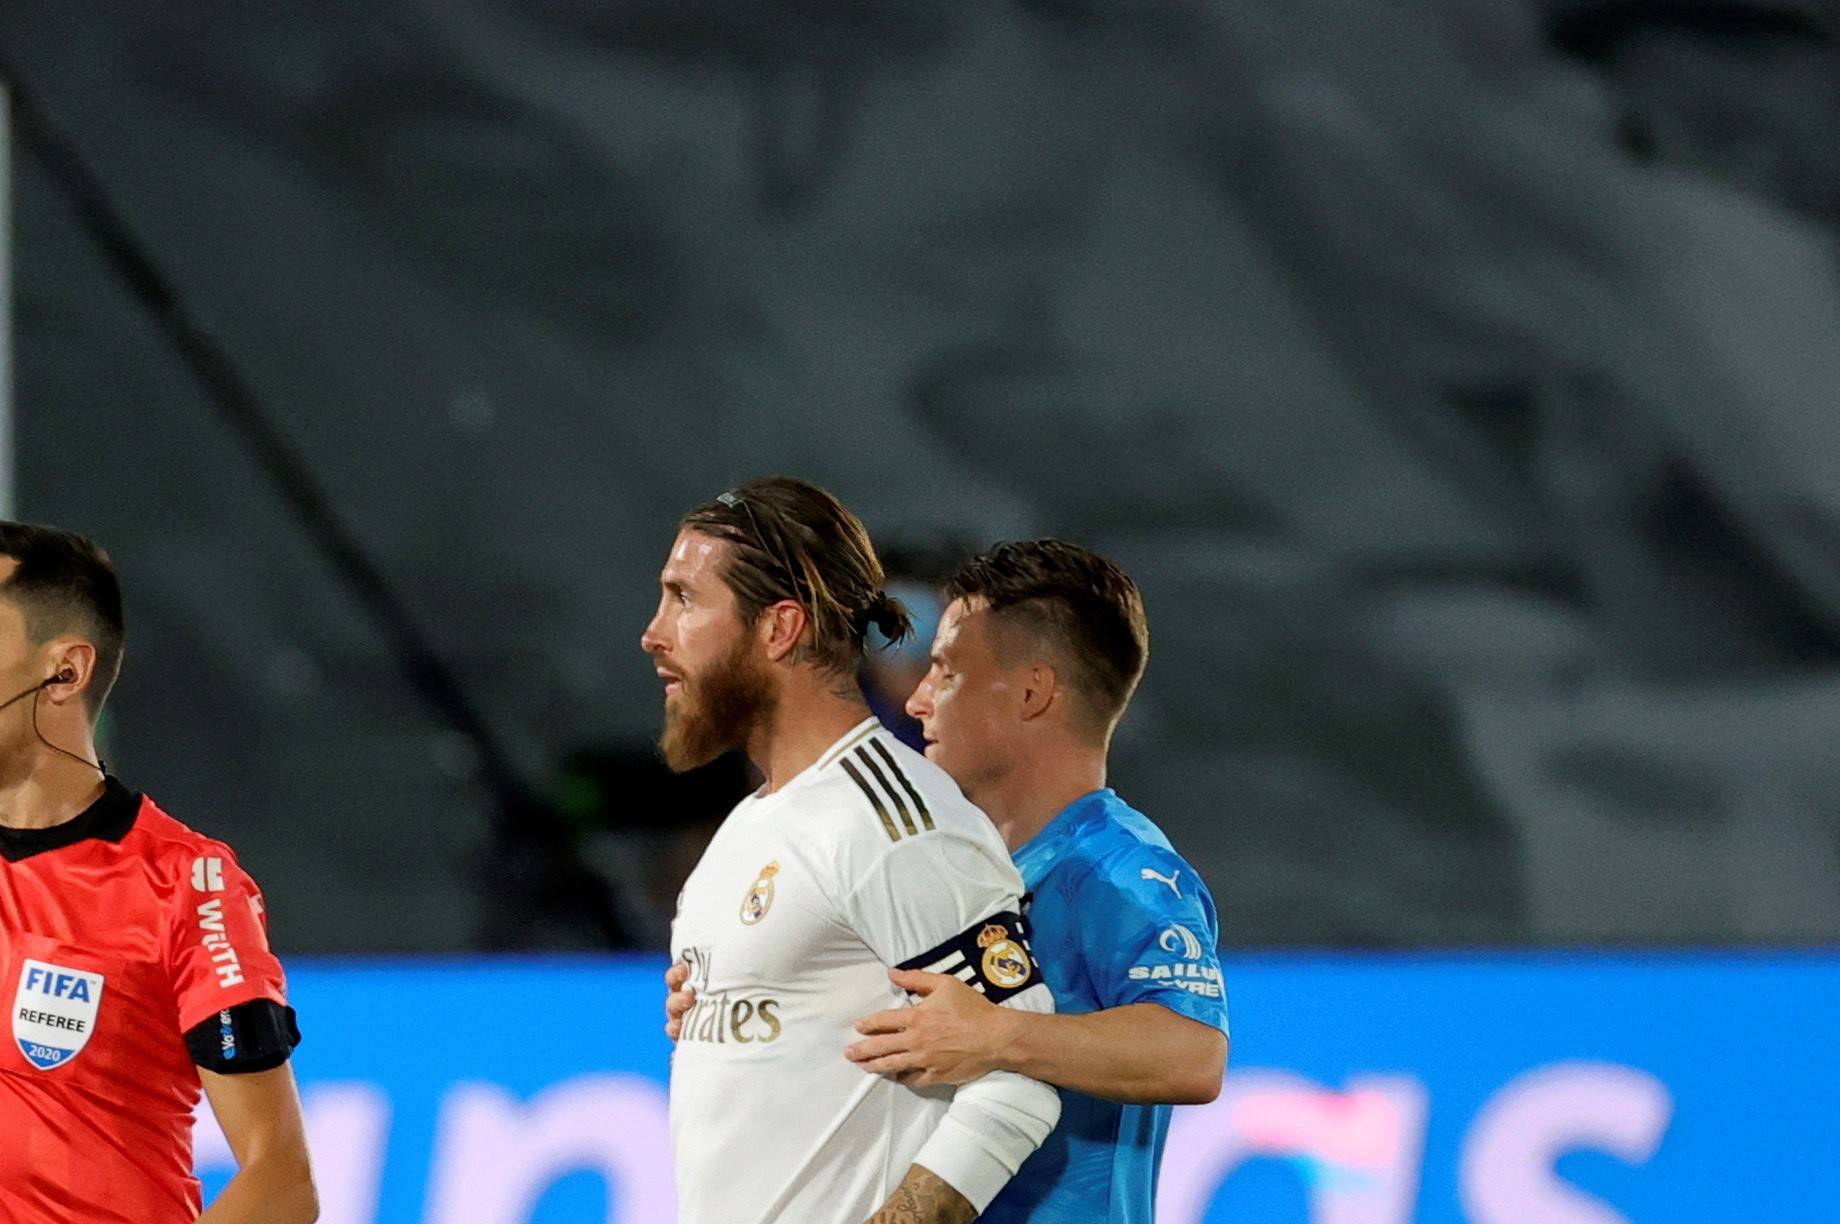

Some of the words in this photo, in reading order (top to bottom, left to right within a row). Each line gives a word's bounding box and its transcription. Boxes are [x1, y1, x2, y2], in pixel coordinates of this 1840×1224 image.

[26, 967, 91, 1004] FIFA
[19, 1008, 87, 1033] REFEREE
[28, 1043, 62, 1062] 2020
